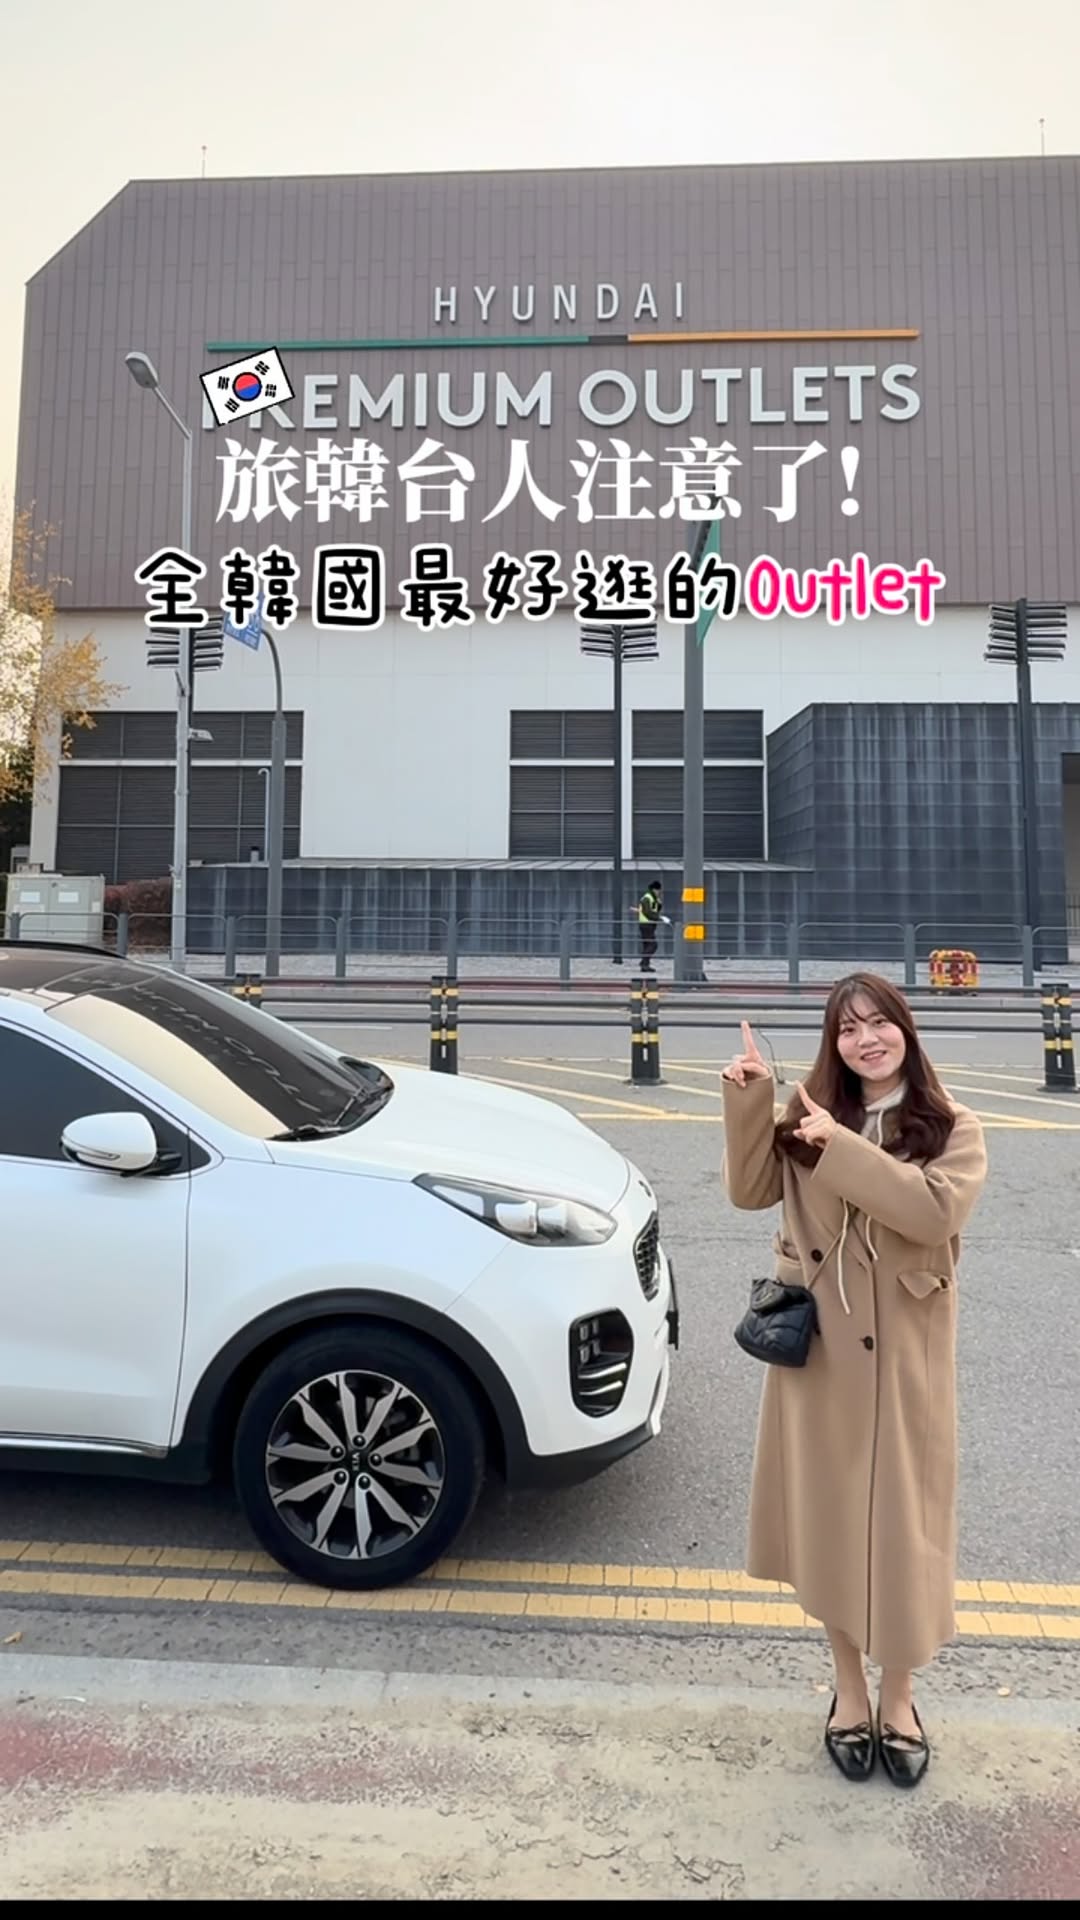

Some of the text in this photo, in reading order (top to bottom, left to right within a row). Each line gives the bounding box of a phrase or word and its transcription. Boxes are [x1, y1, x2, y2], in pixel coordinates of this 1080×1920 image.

[434, 281, 684, 323] HYUNDAI
[202, 363, 922, 430] EMIUM OUTLETS
